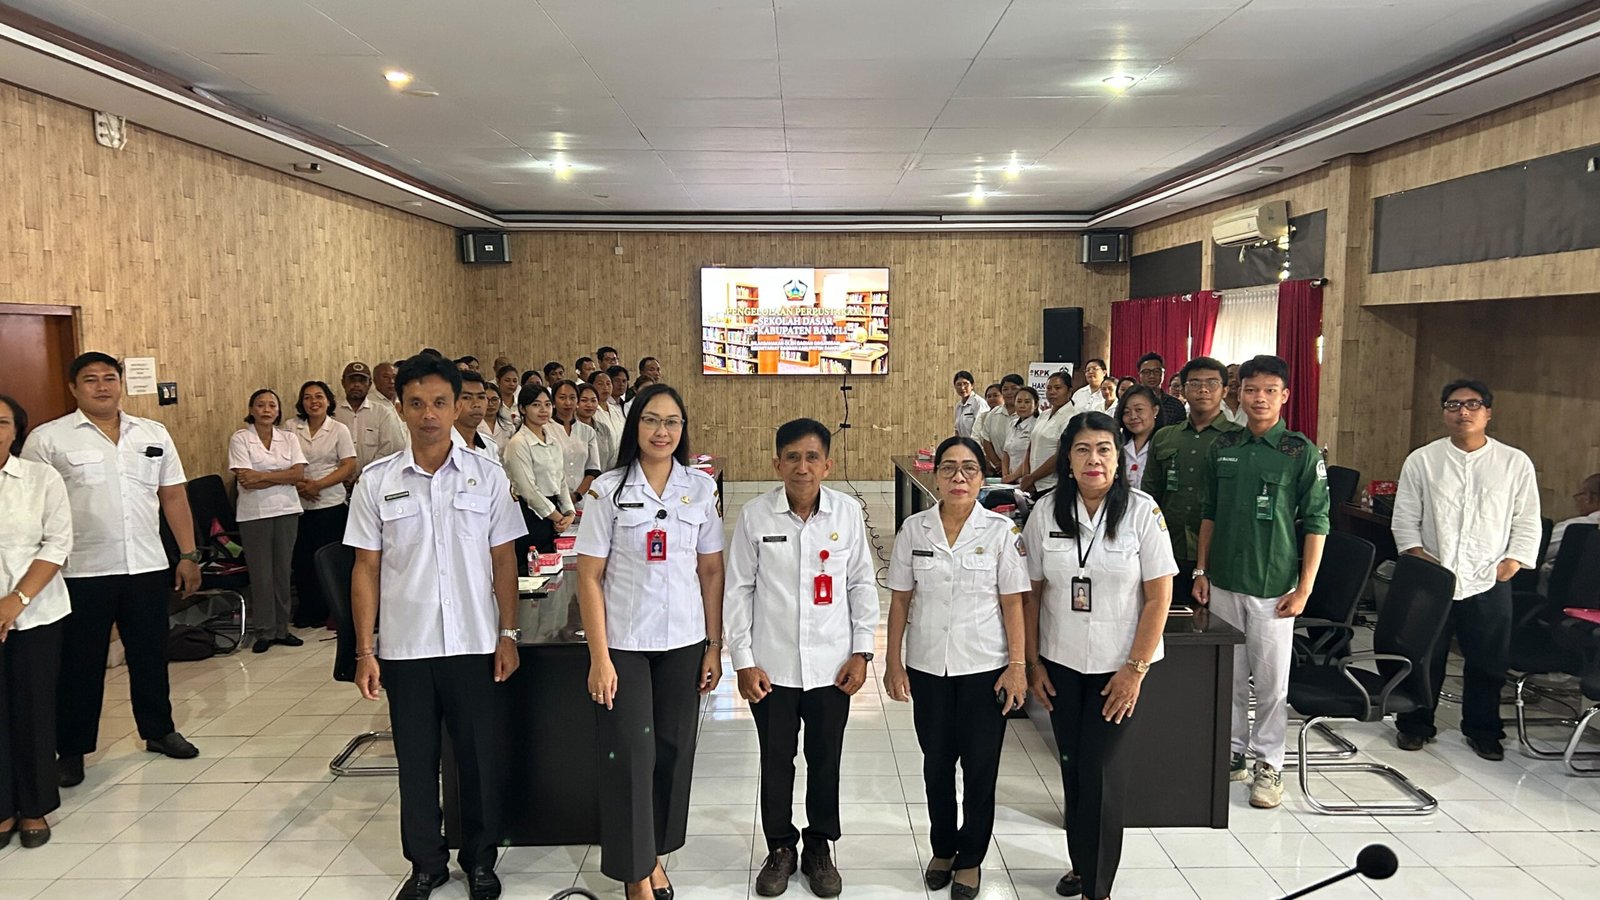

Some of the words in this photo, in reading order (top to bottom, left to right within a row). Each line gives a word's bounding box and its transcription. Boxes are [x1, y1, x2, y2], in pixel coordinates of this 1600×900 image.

[726, 307, 793, 316] PENGELOLAAN
[795, 307, 867, 316] PERPUSTAKAAN
[759, 317, 801, 326] SEKOLAH
[803, 317, 834, 326] DASAR
[744, 326, 811, 335] SE-KABUPATEN
[813, 326, 848, 335] BANGLI
